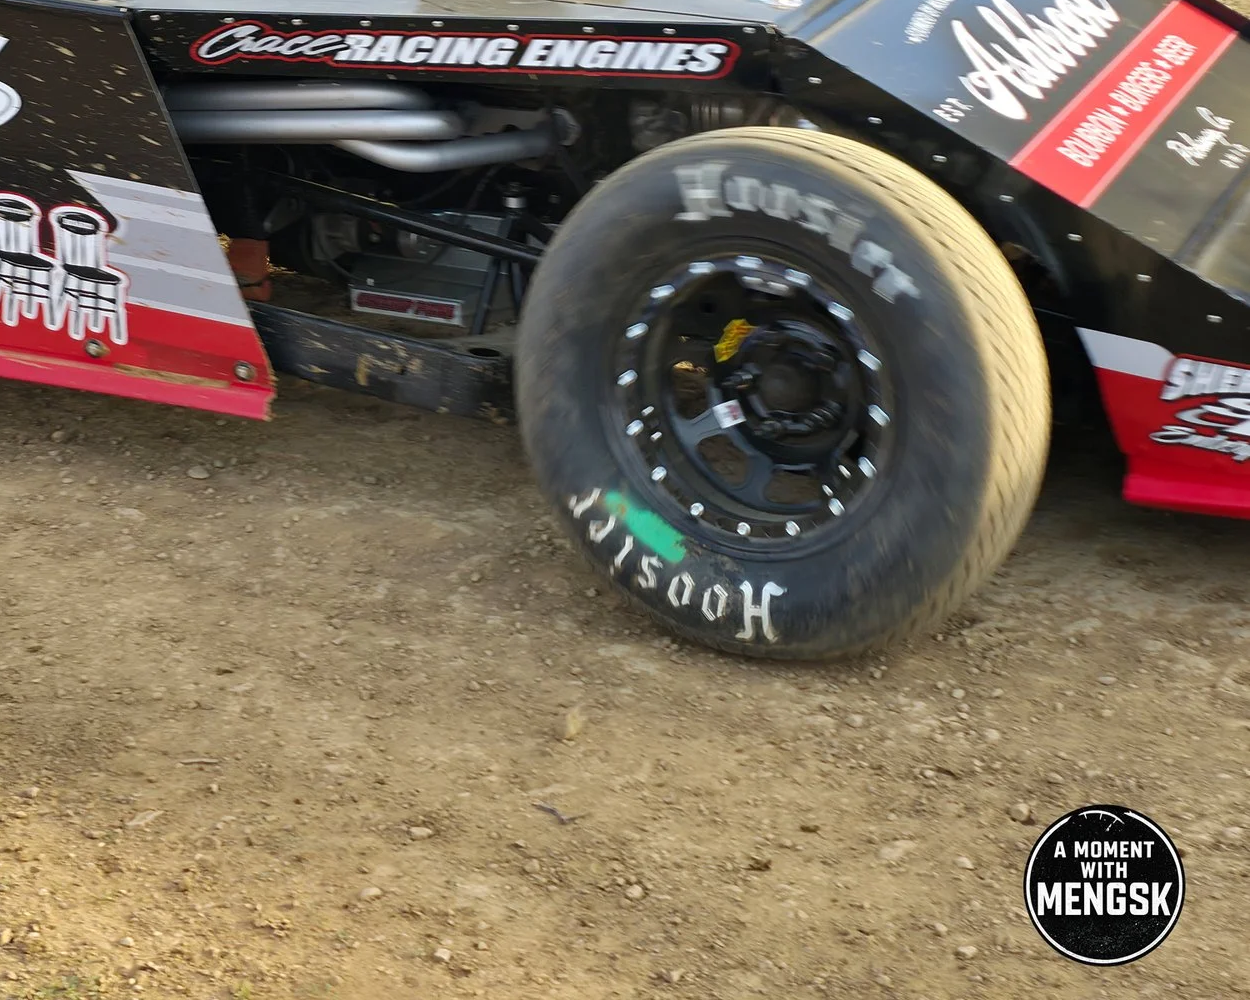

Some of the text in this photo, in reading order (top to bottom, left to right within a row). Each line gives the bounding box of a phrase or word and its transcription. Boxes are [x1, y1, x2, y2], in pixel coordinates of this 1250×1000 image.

[334, 34, 519, 66] RACING
[517, 39, 729, 72] ENGINES
[1056, 35, 1198, 167] BOURBON BURGERS BEER
